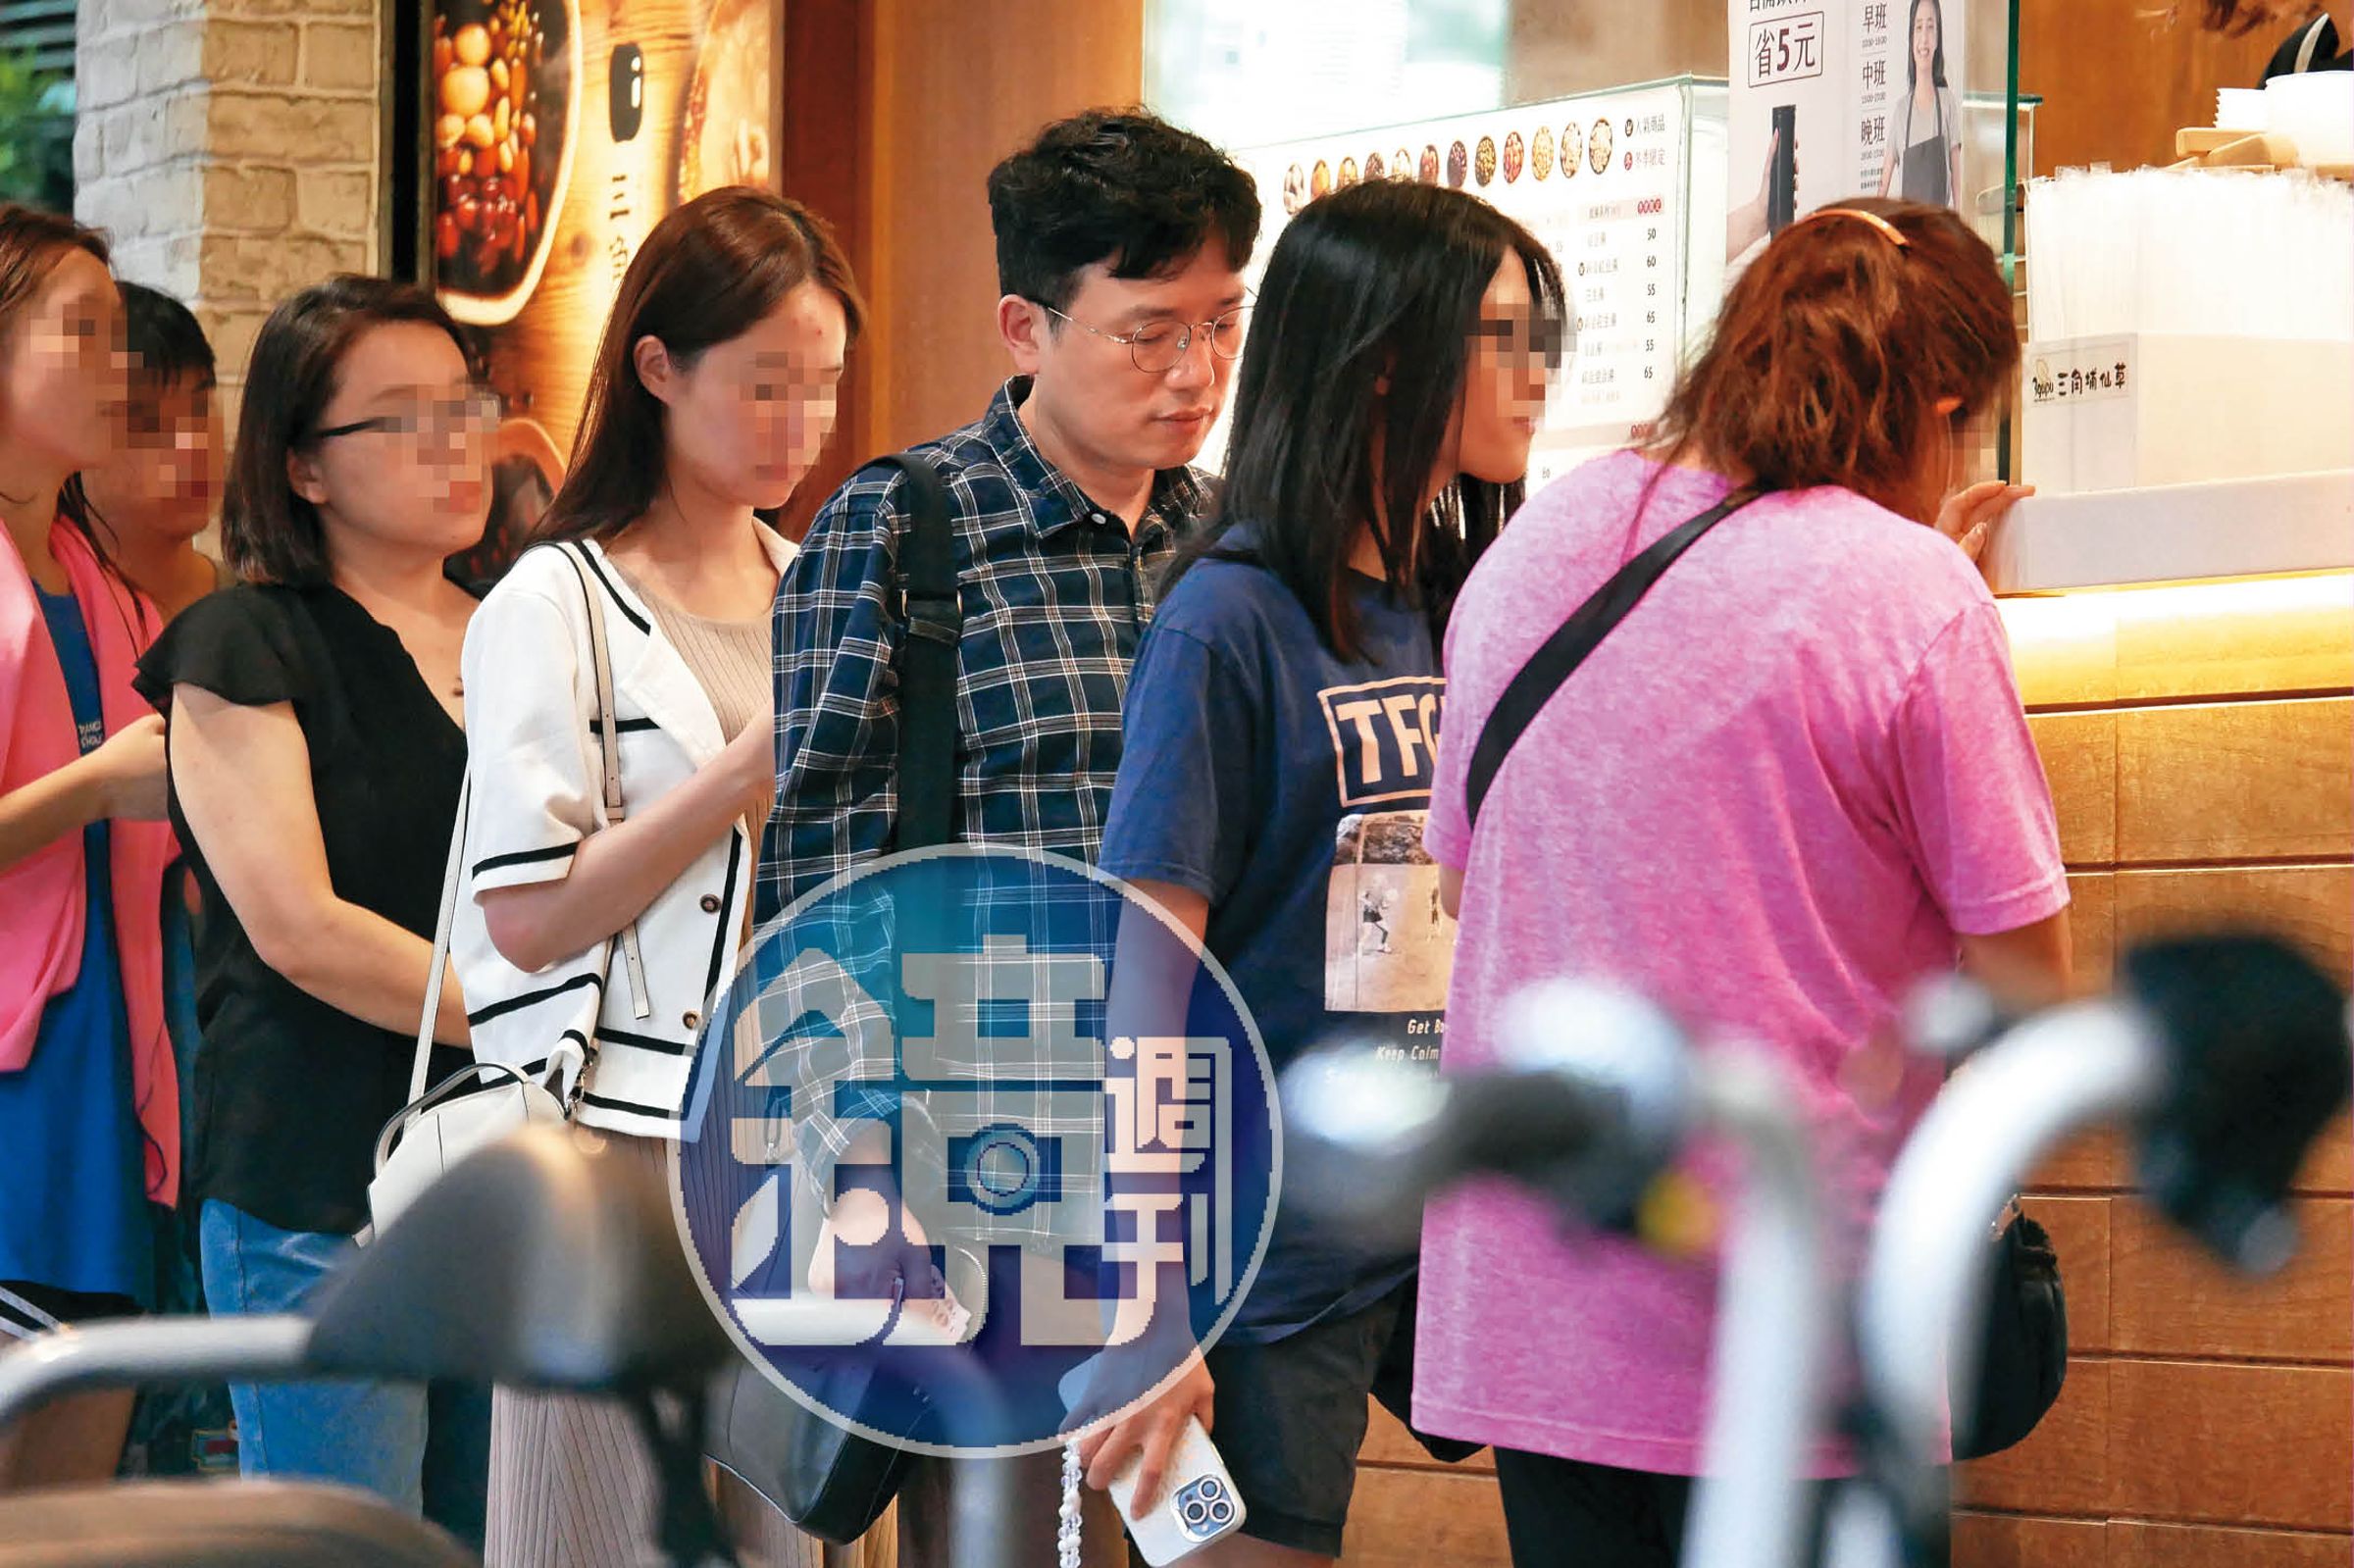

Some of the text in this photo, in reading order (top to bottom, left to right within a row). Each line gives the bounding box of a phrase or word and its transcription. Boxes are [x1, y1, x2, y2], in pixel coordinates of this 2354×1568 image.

[1864, 3, 1887, 32] 早班
[1756, 23, 1815, 78] 省5元
[1863, 60, 1886, 90] 中班
[1861, 115, 1884, 146] 晚班
[1647, 228, 1657, 241] 50
[1646, 255, 1657, 268] 60
[1647, 283, 1656, 296] 55
[1646, 311, 1656, 324] 65
[1645, 339, 1655, 352] 55
[1644, 367, 1654, 379] 65
[2058, 362, 2126, 396] 三角埔仙草
[1337, 693, 1446, 784] TFG
[1407, 1018, 1431, 1035] Get
[1375, 1044, 1440, 1062] Keep Calm
